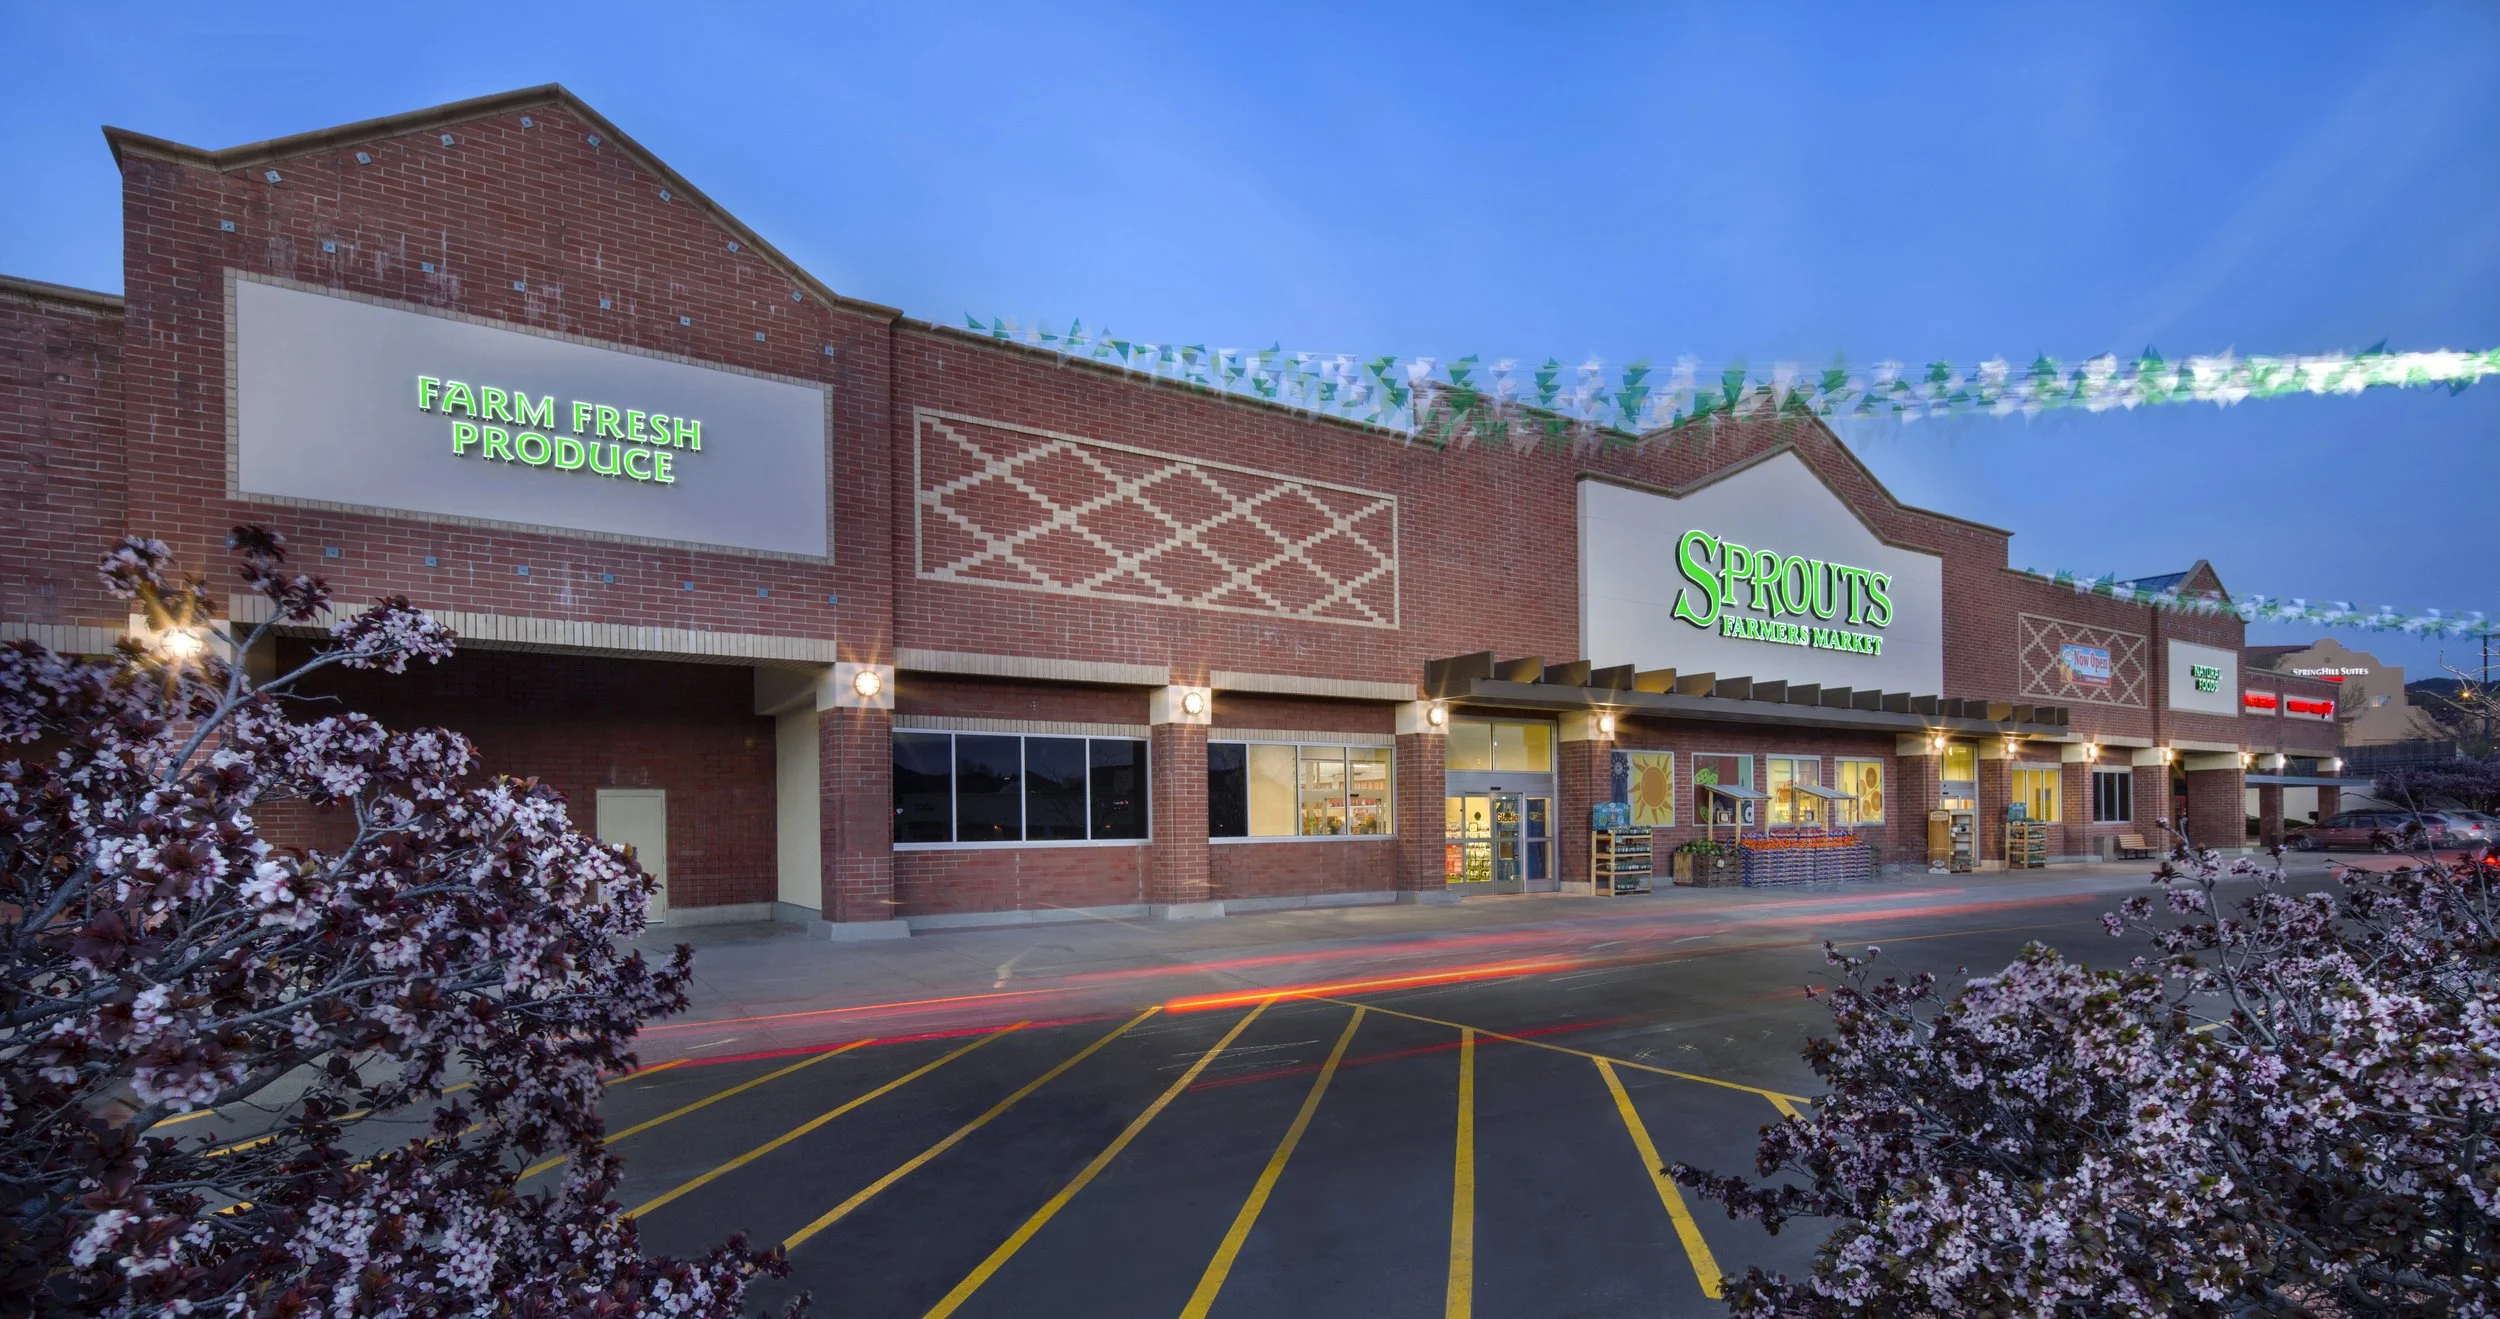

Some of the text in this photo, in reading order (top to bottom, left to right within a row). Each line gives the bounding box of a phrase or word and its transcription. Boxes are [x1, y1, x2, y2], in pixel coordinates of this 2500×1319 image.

[417, 375, 702, 452] FARM FRESH
[452, 421, 675, 484] PRODUCE
[1672, 529, 1894, 629] SPROUTS
[1721, 614, 1884, 656] FARMERS MARKET
[2074, 650, 2108, 673] Now Open
[2197, 679, 2219, 693] FOODS
